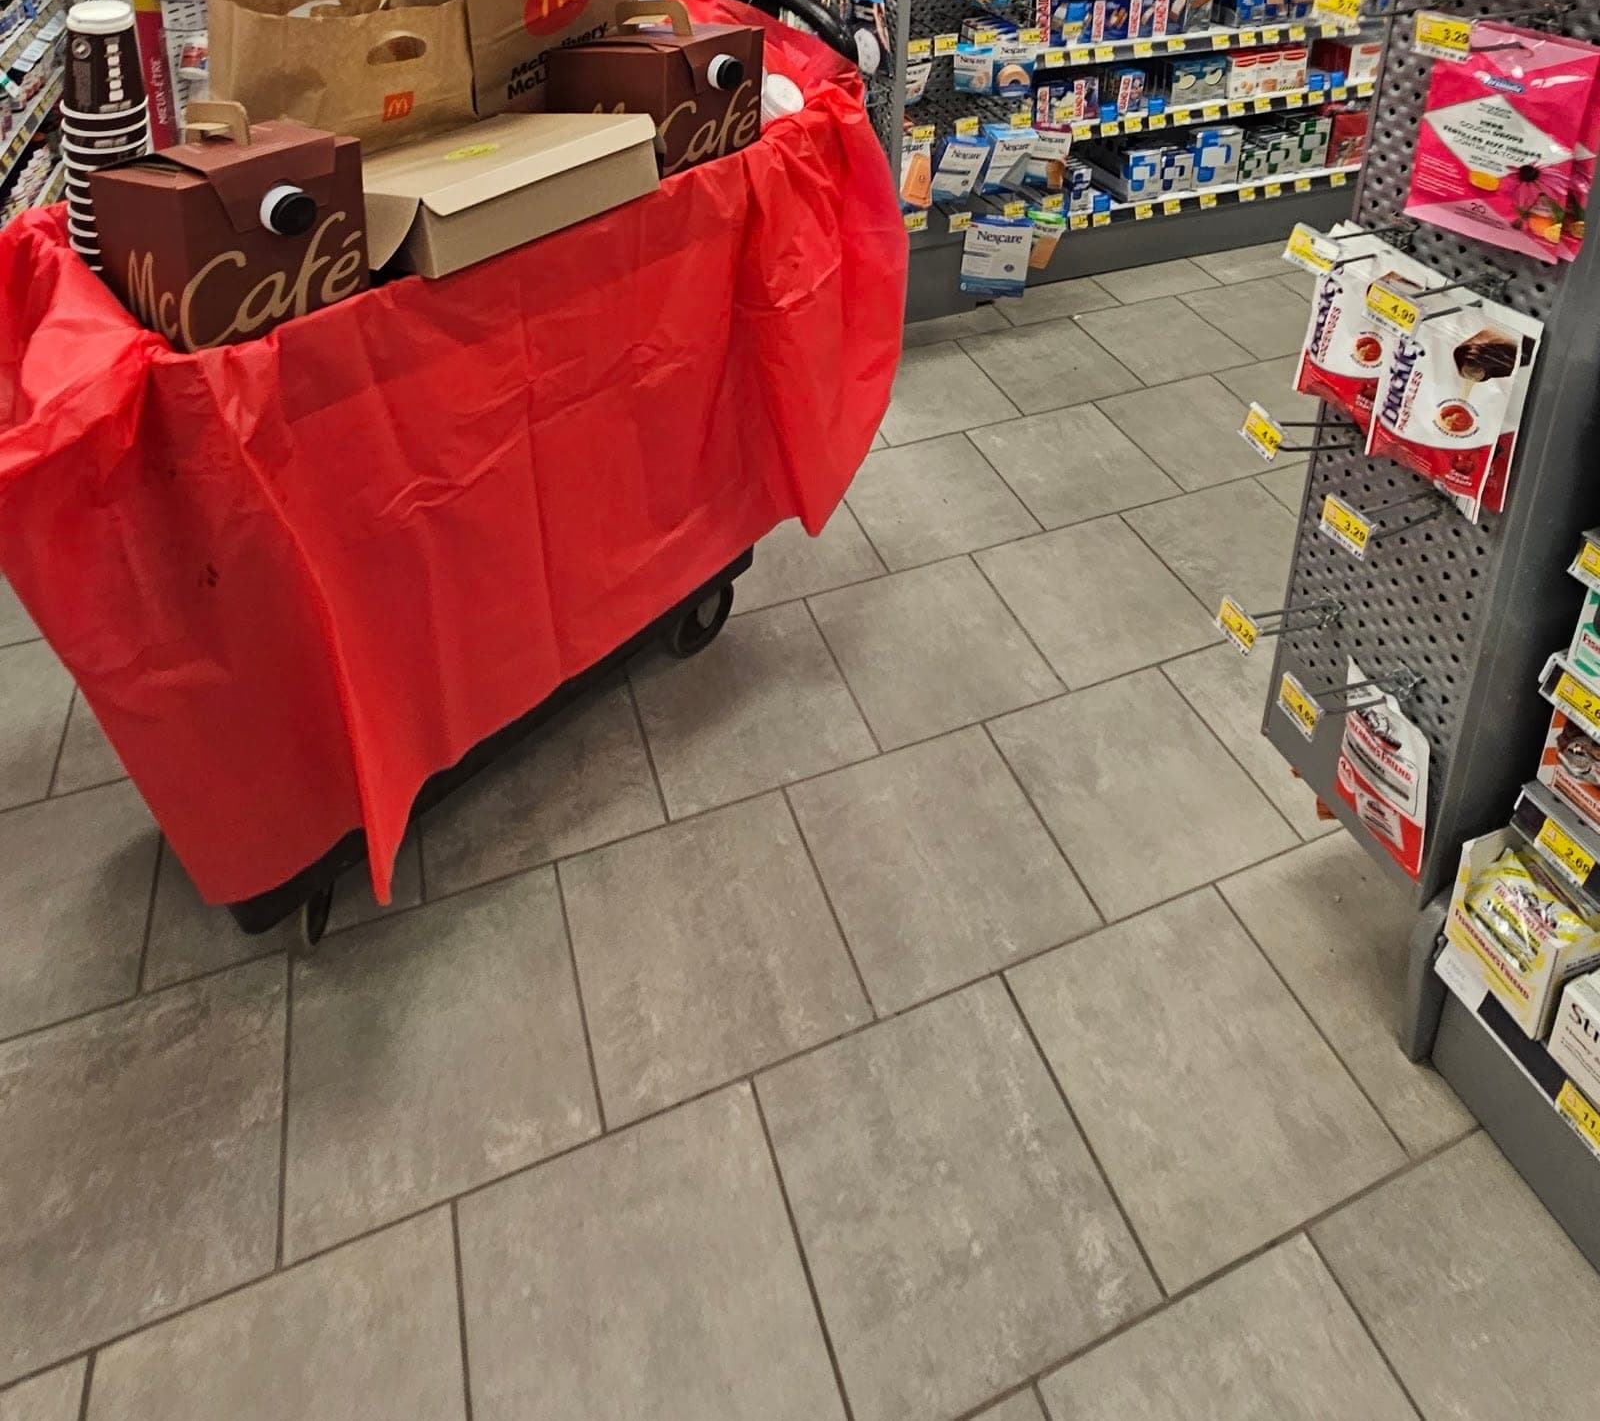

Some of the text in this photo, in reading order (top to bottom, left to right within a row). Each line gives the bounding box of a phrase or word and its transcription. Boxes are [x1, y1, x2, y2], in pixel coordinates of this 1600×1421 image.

[977, 230, 1024, 245] Nexcare
[1390, 303, 1416, 324] 4.99
[1344, 521, 1367, 543] 3.29
[1235, 621, 1256, 644] 3.29
[1583, 699, 1600, 720] 2.6
[1565, 847, 1591, 875] 2.69
